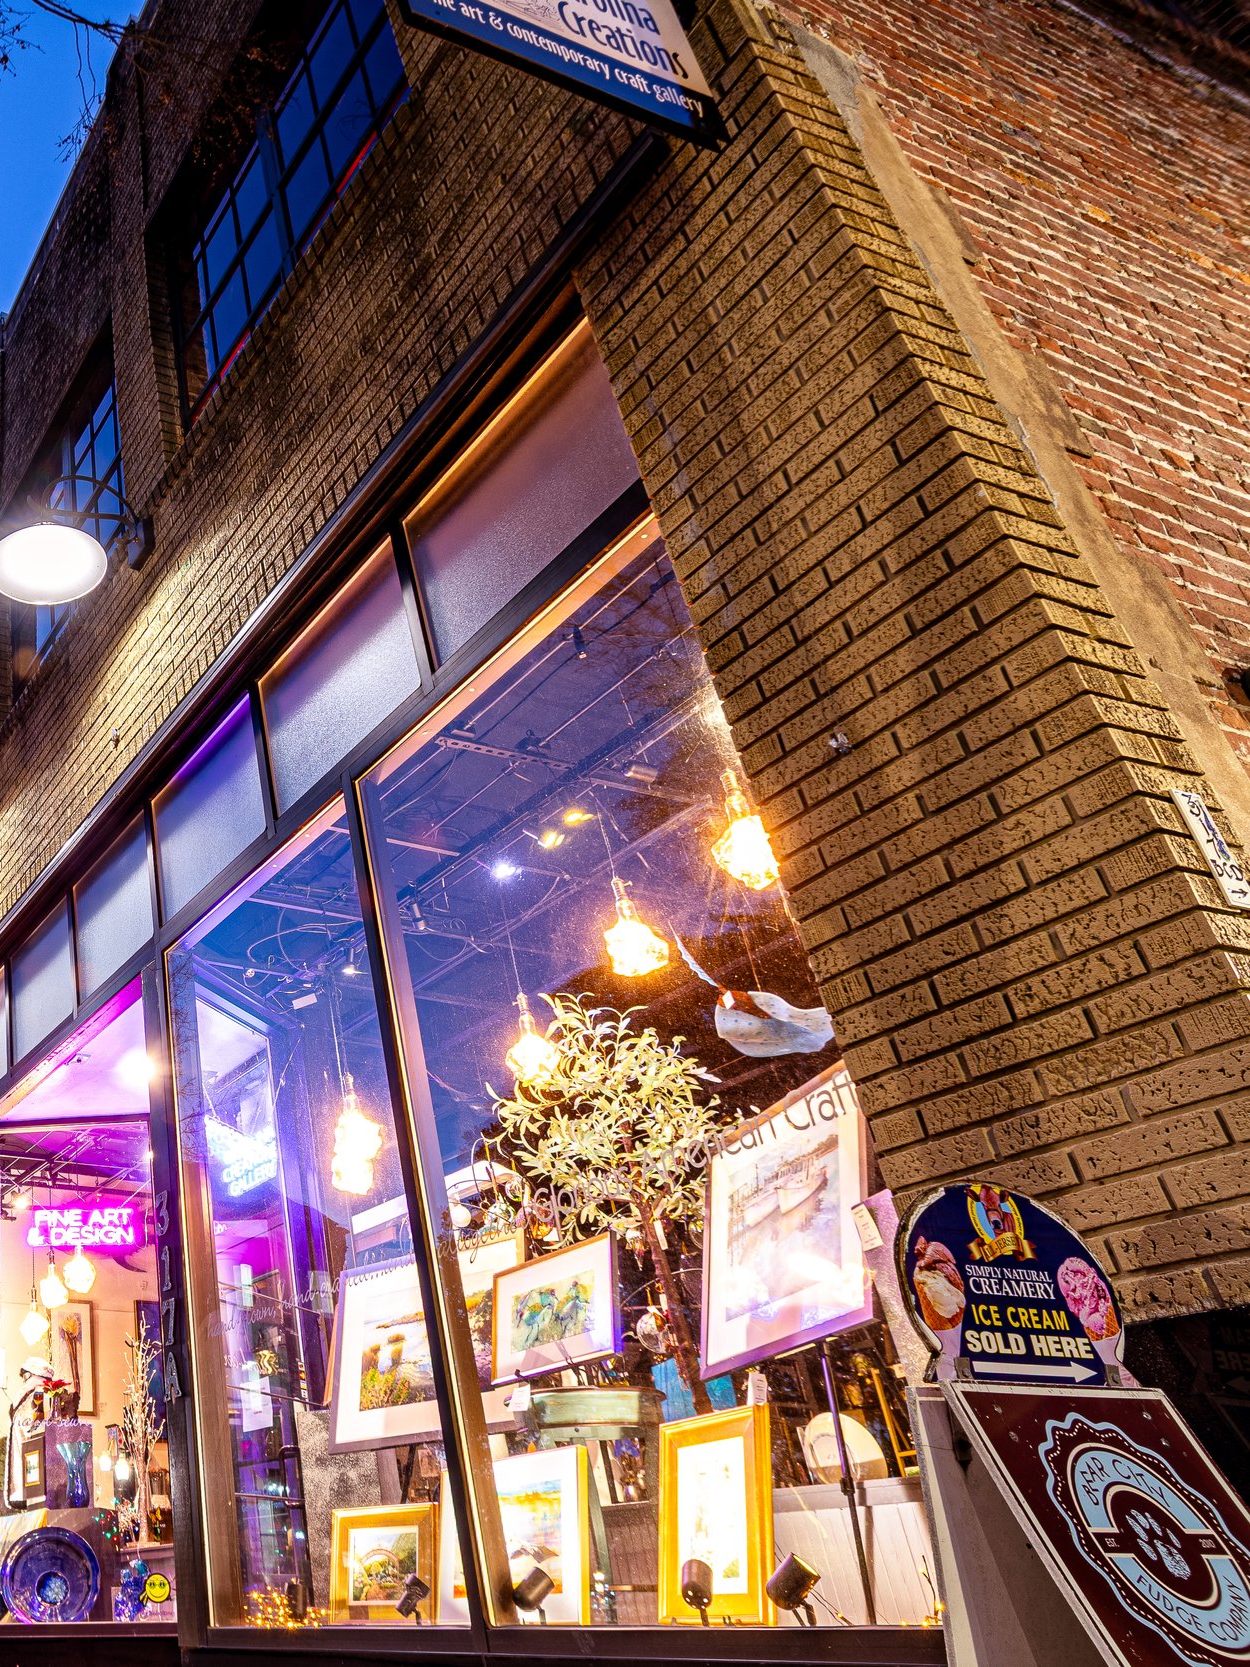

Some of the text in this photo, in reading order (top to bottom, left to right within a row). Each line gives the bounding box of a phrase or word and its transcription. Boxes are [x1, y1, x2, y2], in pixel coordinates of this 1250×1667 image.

[558, 1, 689, 79] Creations
[459, 3, 486, 24] art
[489, 11, 504, 30] &
[507, 22, 610, 80] contemporary
[614, 68, 651, 94] craft
[653, 84, 703, 118] gallery
[34, 1208, 133, 1229] FINE ART
[49, 1226, 135, 1245] DESIGN
[965, 1264, 1052, 1283] SIMPLY NATURAL
[969, 1276, 1056, 1300] CREAMERY
[971, 1304, 1070, 1331] ICE CREAM
[964, 1330, 1094, 1359] SOLD HERE
[1079, 1456, 1171, 1509] BEAR CITY
[1105, 1538, 1120, 1548] EST.
[1136, 1575, 1250, 1642] FUDGE COMPANY
